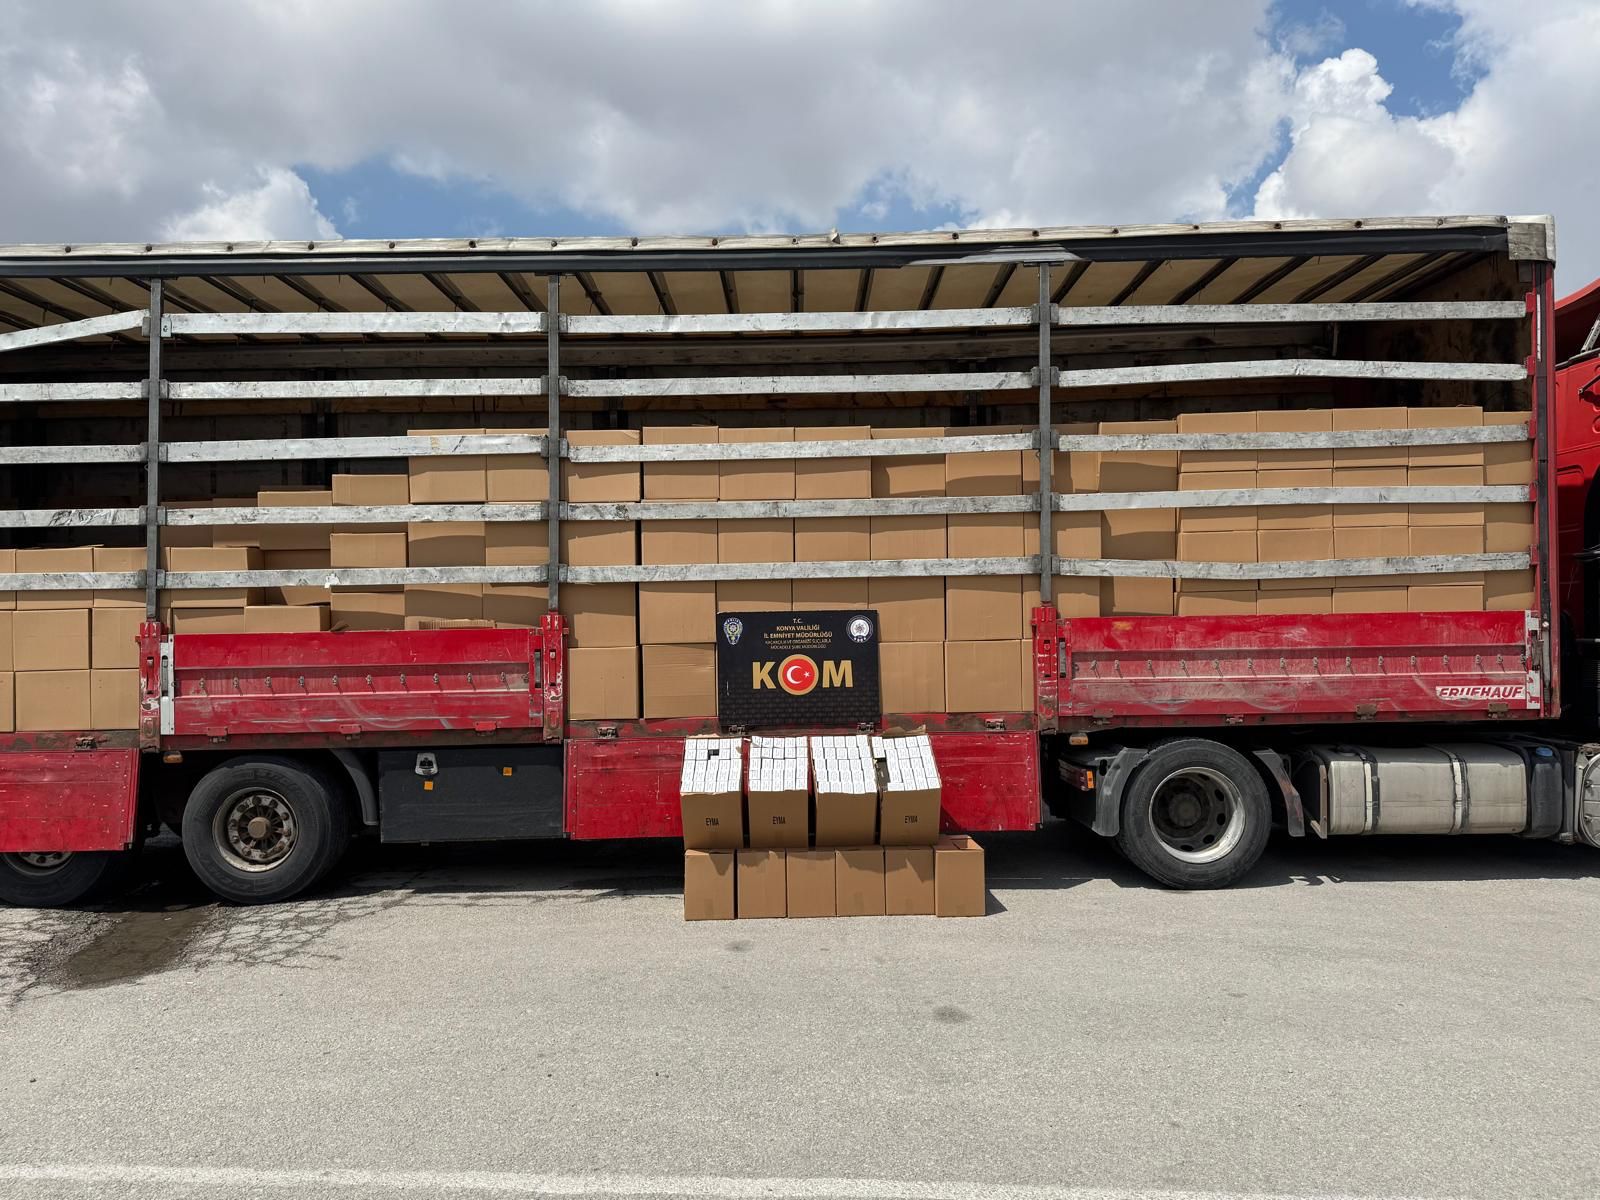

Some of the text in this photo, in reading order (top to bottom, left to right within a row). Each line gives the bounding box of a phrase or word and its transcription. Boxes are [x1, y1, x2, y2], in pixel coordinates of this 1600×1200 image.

[752, 654, 854, 696] KOM
[706, 818, 719, 826] EYMA
[772, 816, 785, 825] EYMA
